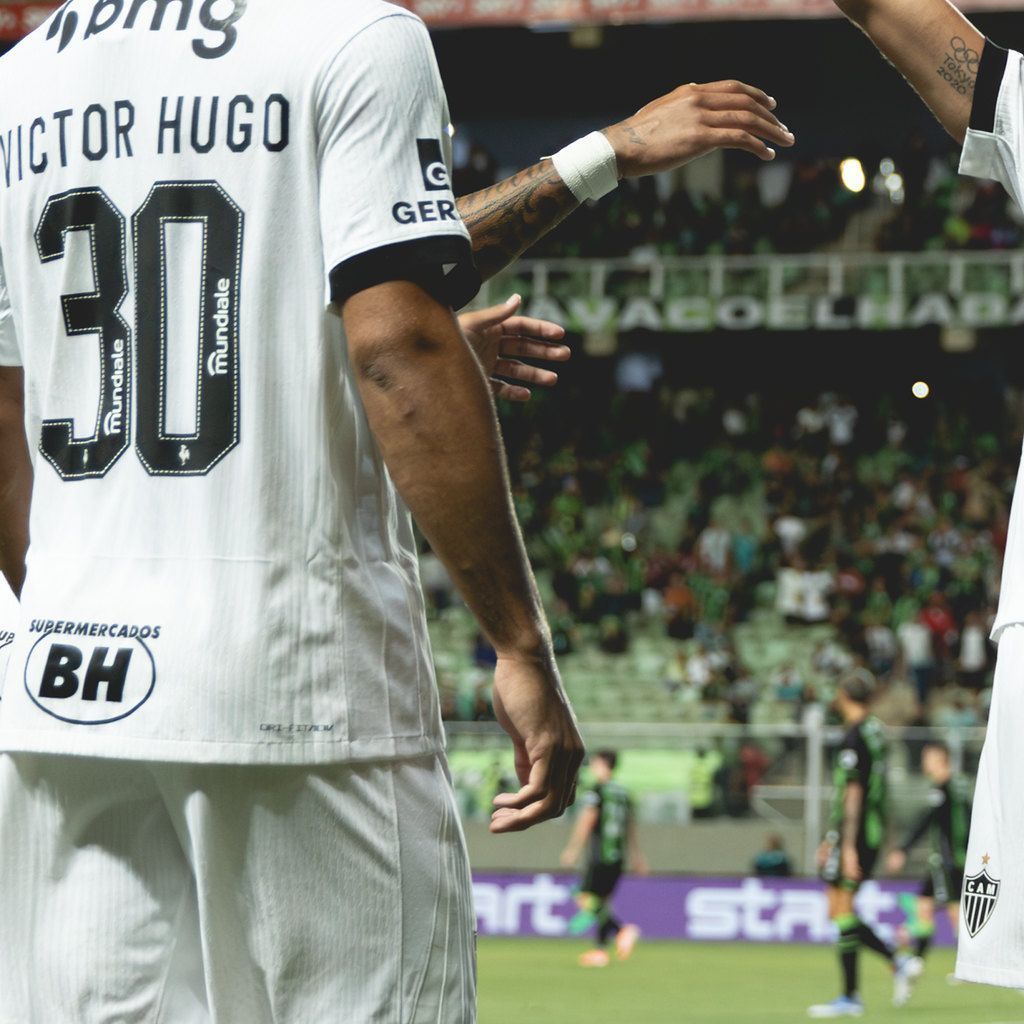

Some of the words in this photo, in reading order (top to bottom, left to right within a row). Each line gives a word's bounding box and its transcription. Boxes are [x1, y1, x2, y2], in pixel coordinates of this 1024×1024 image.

[0, 99, 136, 188] VICTOR
[157, 93, 290, 154] HUGO
[391, 199, 458, 225] GER
[34, 179, 245, 482] 30
[207, 278, 231, 377] mundiale
[104, 338, 125, 436] mundiale
[29, 619, 161, 639] SUPERMERCADOS
[38, 643, 134, 702] BH
[472, 873, 569, 936] art
[685, 877, 896, 946] stat
[967, 880, 996, 896] CAM
